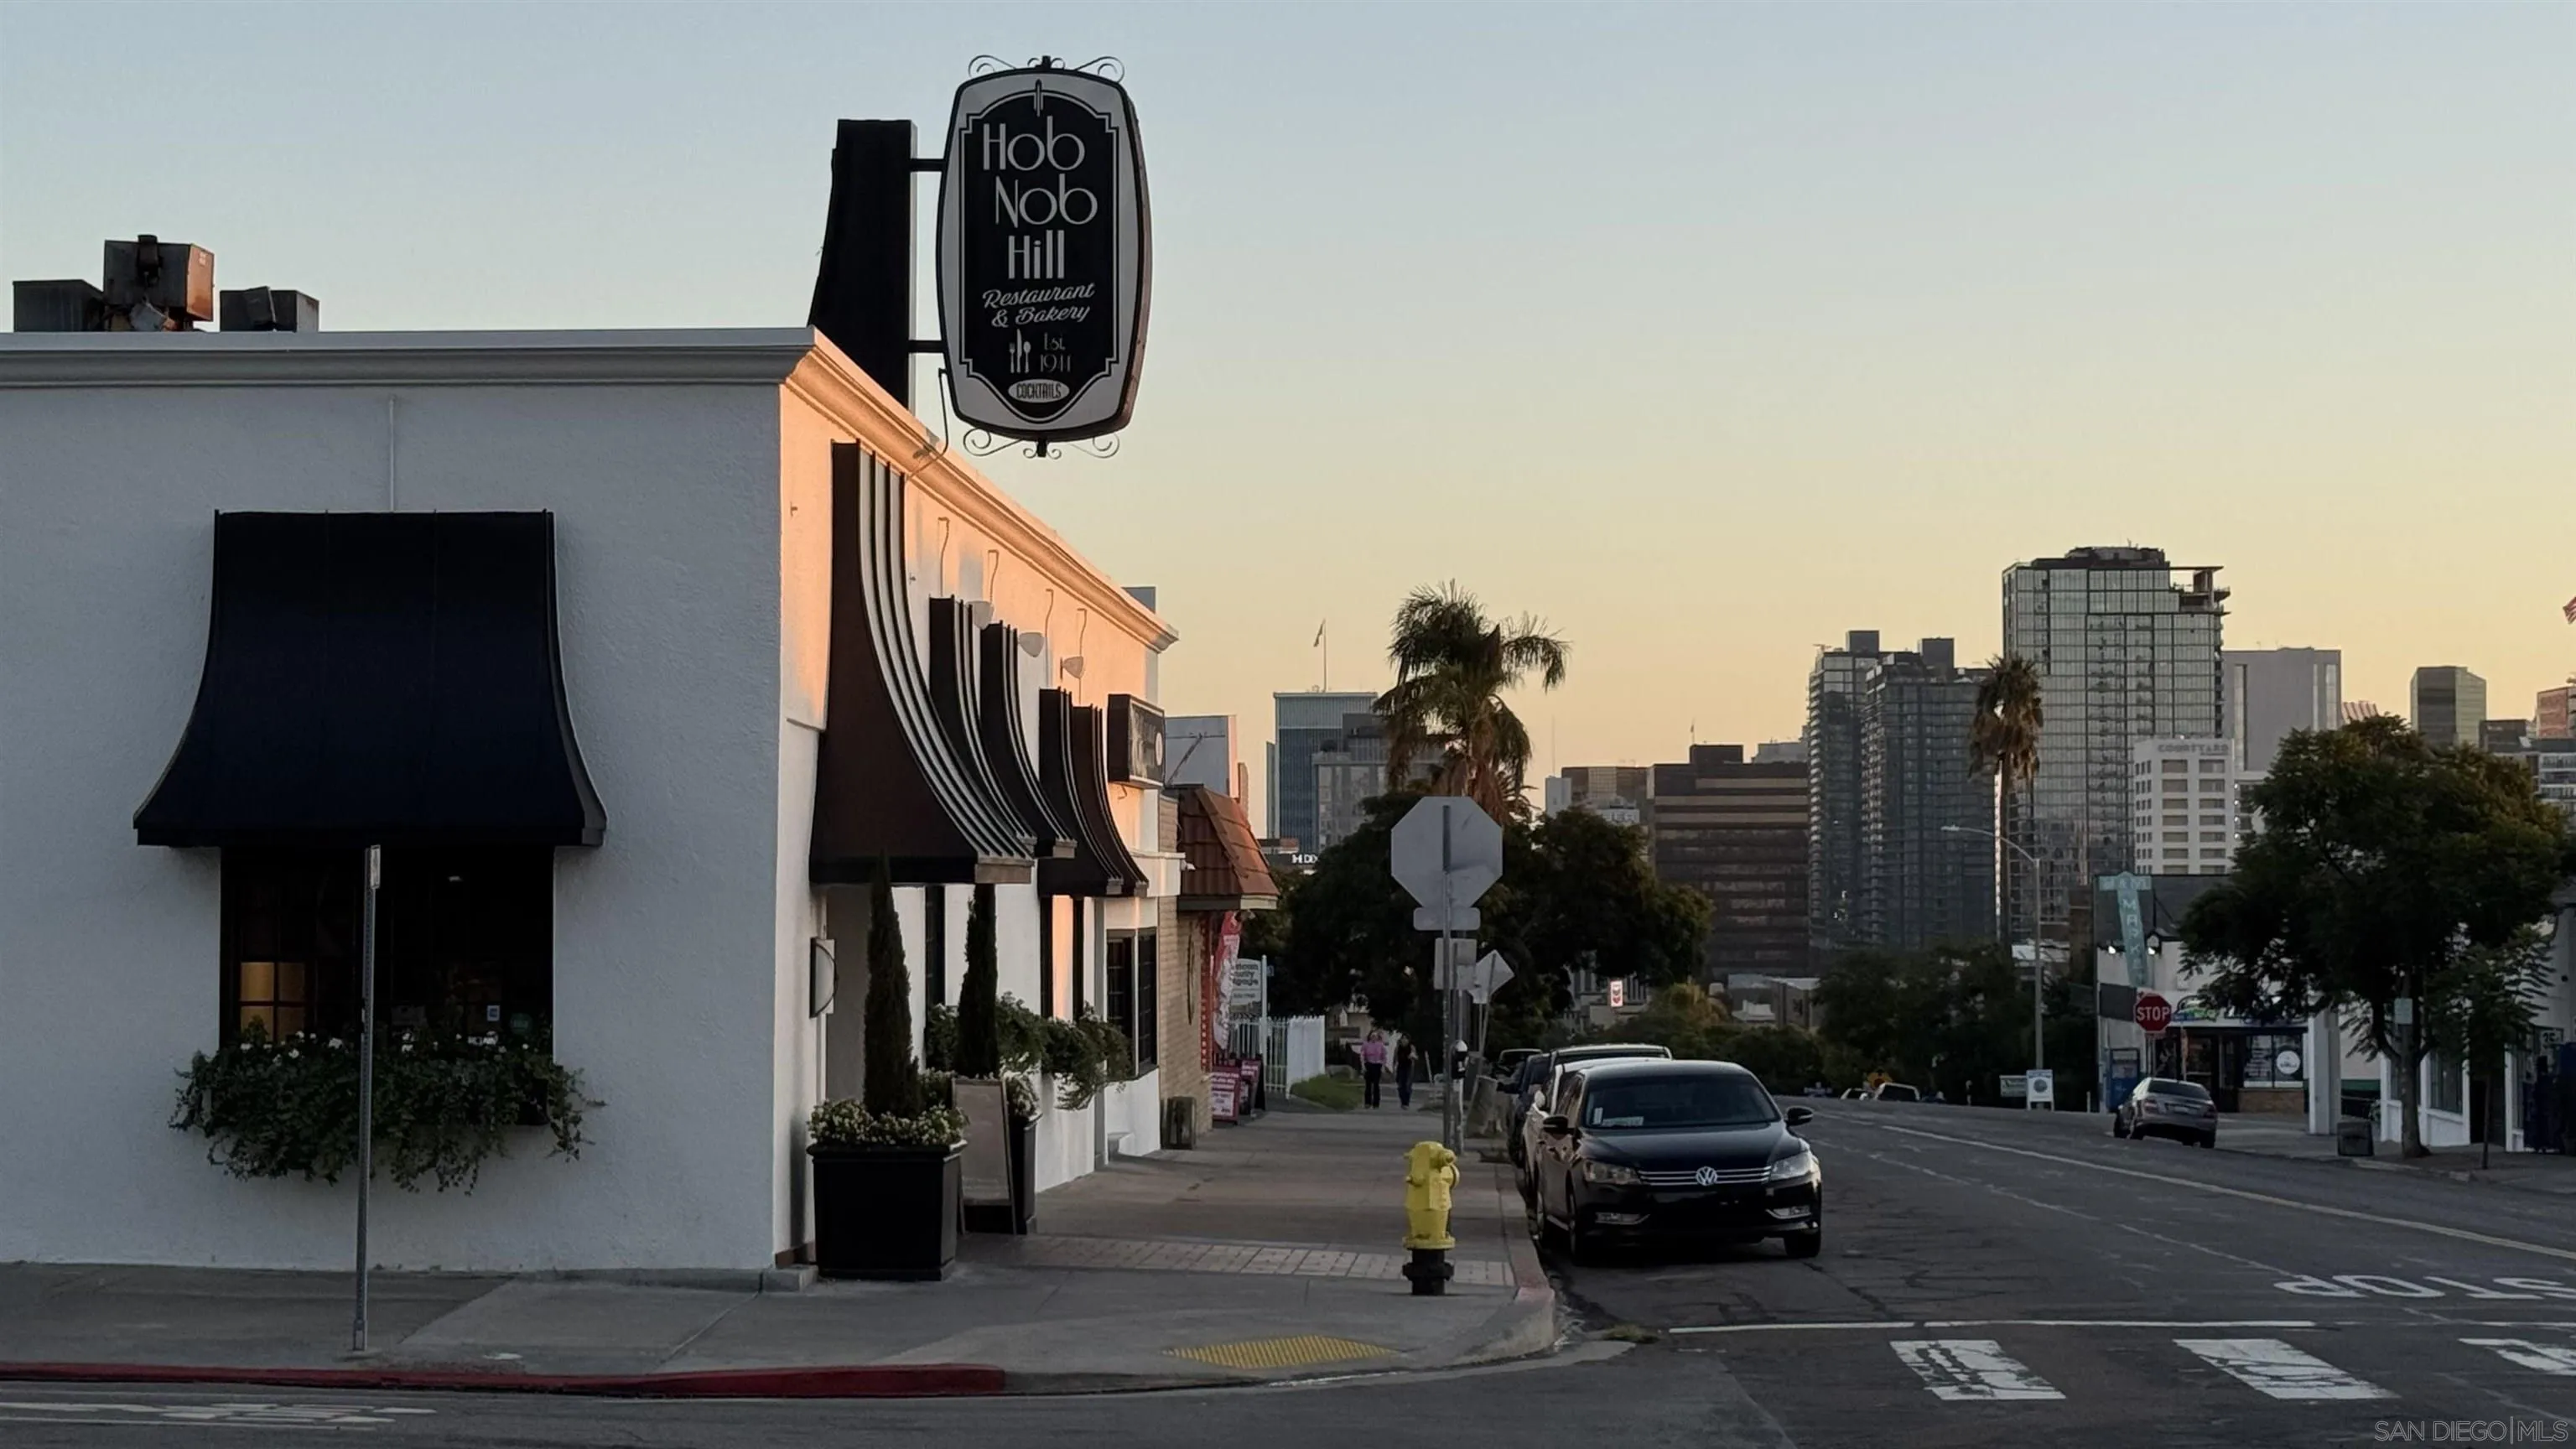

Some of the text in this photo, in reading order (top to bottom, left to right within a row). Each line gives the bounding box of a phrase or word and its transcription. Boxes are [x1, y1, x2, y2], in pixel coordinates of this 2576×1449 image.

[983, 115, 1085, 171] Hob
[995, 173, 1098, 228] Nob
[1008, 229, 1065, 279] Hill
[982, 282, 1095, 309] Restaurant
[991, 305, 1091, 328] & Bakery
[1016, 383, 1062, 399] COCKTAILS
[2158, 744, 2229, 753] COURTYARD
[2136, 1005, 2170, 1021] STOP
